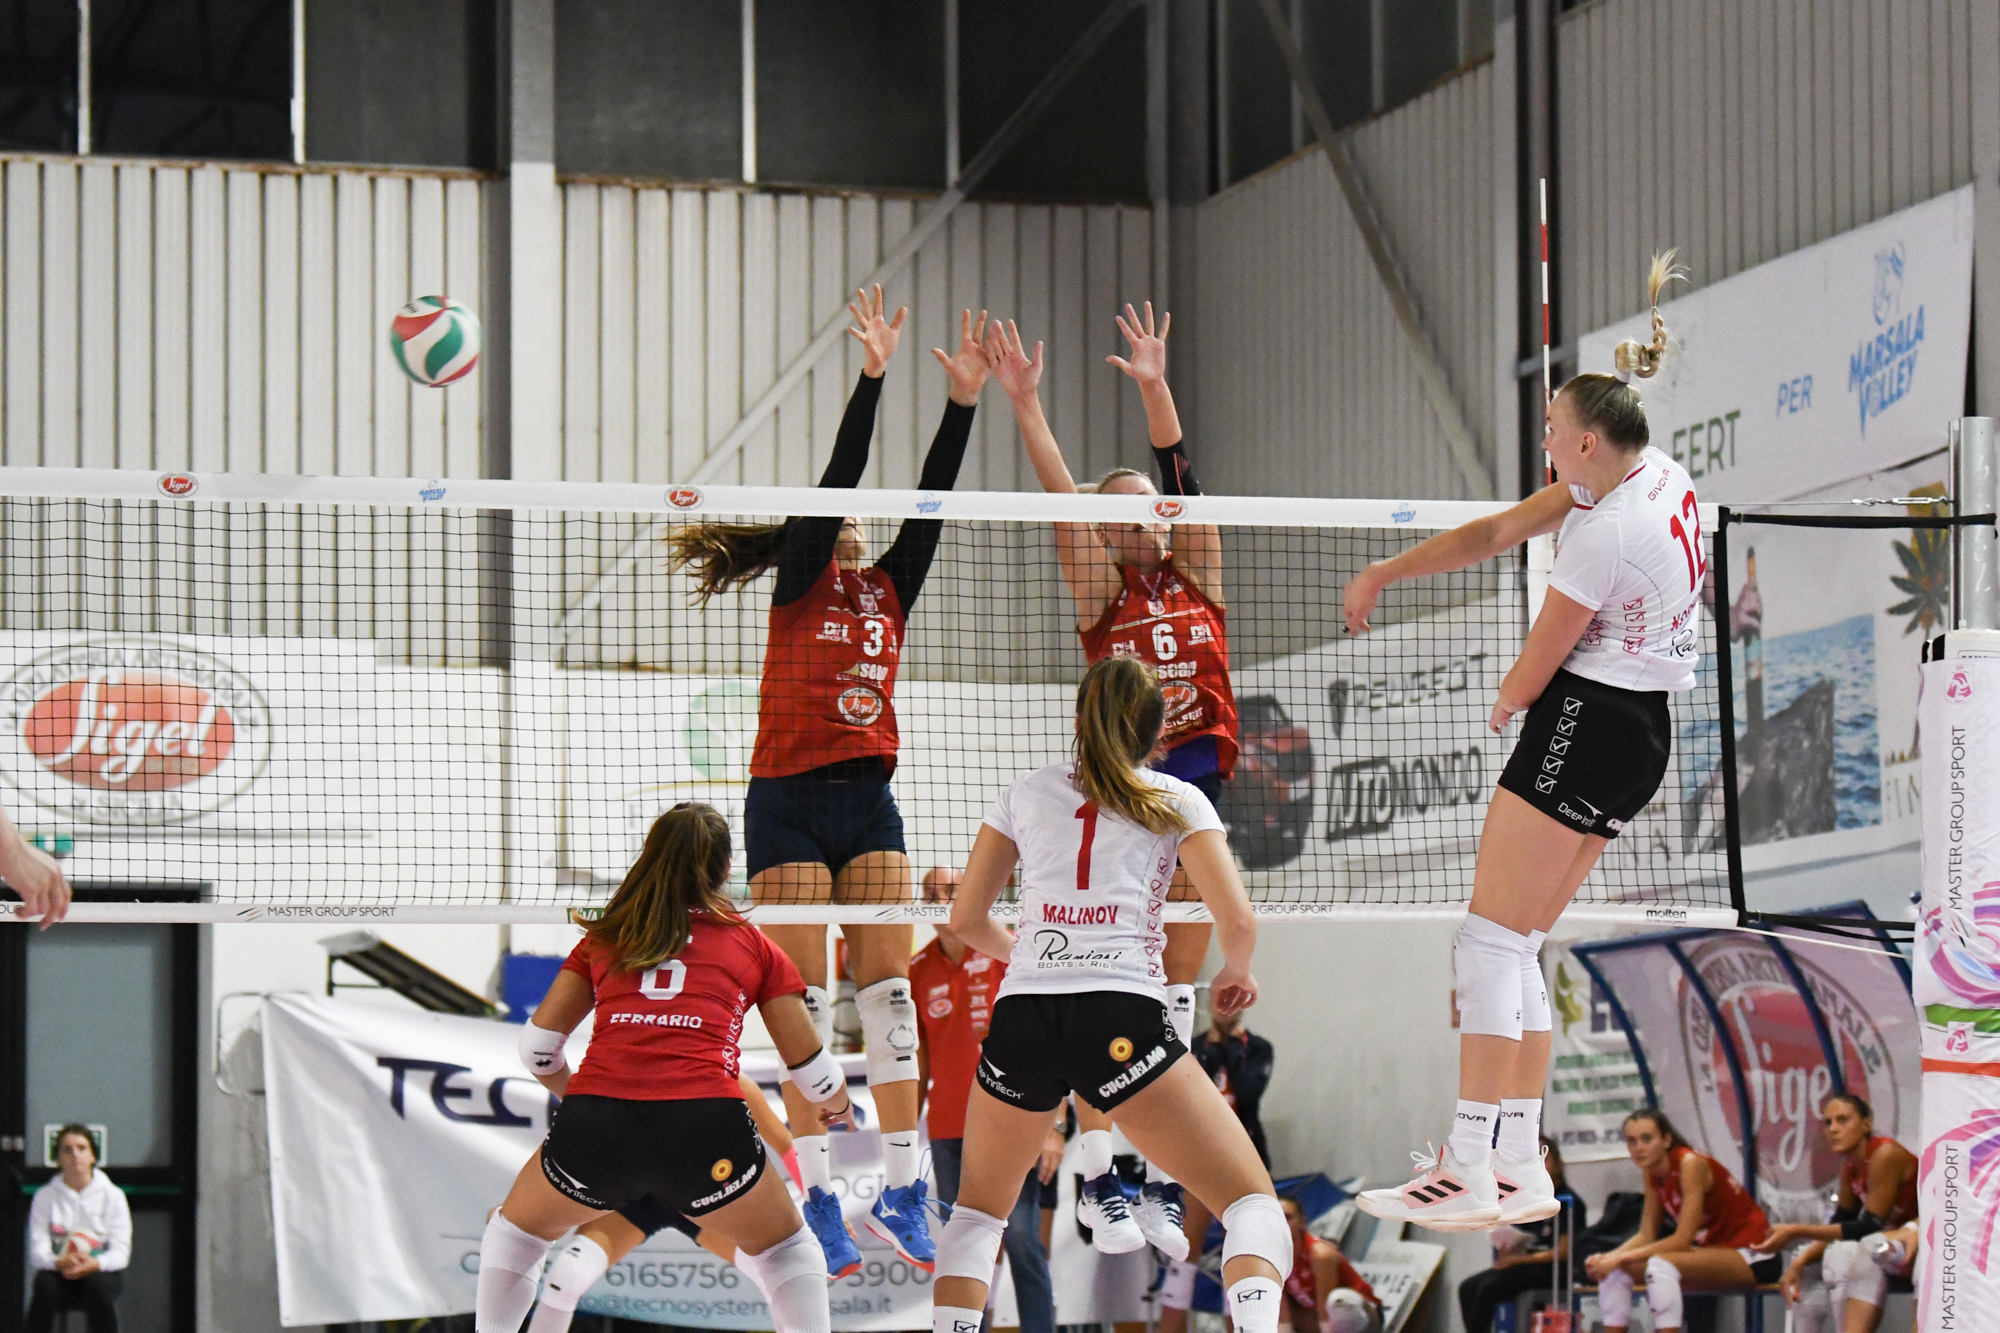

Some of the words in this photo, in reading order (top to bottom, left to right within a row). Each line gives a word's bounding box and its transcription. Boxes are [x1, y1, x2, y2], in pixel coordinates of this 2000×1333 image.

[1848, 304, 1925, 393] MARSALA
[1776, 374, 1814, 420] PER
[1860, 350, 1919, 441] VOLLEY
[1647, 468, 1671, 501] GIVOVA
[1669, 490, 1706, 593] 12
[863, 620, 884, 657] 3
[1152, 623, 1178, 661] 6
[38, 668, 222, 784] Sigel
[1951, 725, 1966, 779] SPORT
[1949, 781, 1965, 843] GROUP
[1074, 801, 1099, 890] 1
[1949, 845, 1963, 910] MASTER
[267, 906, 313, 917] MASTER
[314, 906, 357, 917] GROUP
[358, 906, 397, 917] SPORT
[904, 906, 948, 917] MASTER
[1043, 903, 1119, 925] MALINOV
[1258, 904, 1298, 915] GROUP
[1300, 904, 1335, 915] SPORT
[1646, 908, 1687, 919] molten
[1944, 1143, 1959, 1199] SPORT
[1942, 1200, 1959, 1262] GROUP
[1941, 1264, 1957, 1331] MASTER
